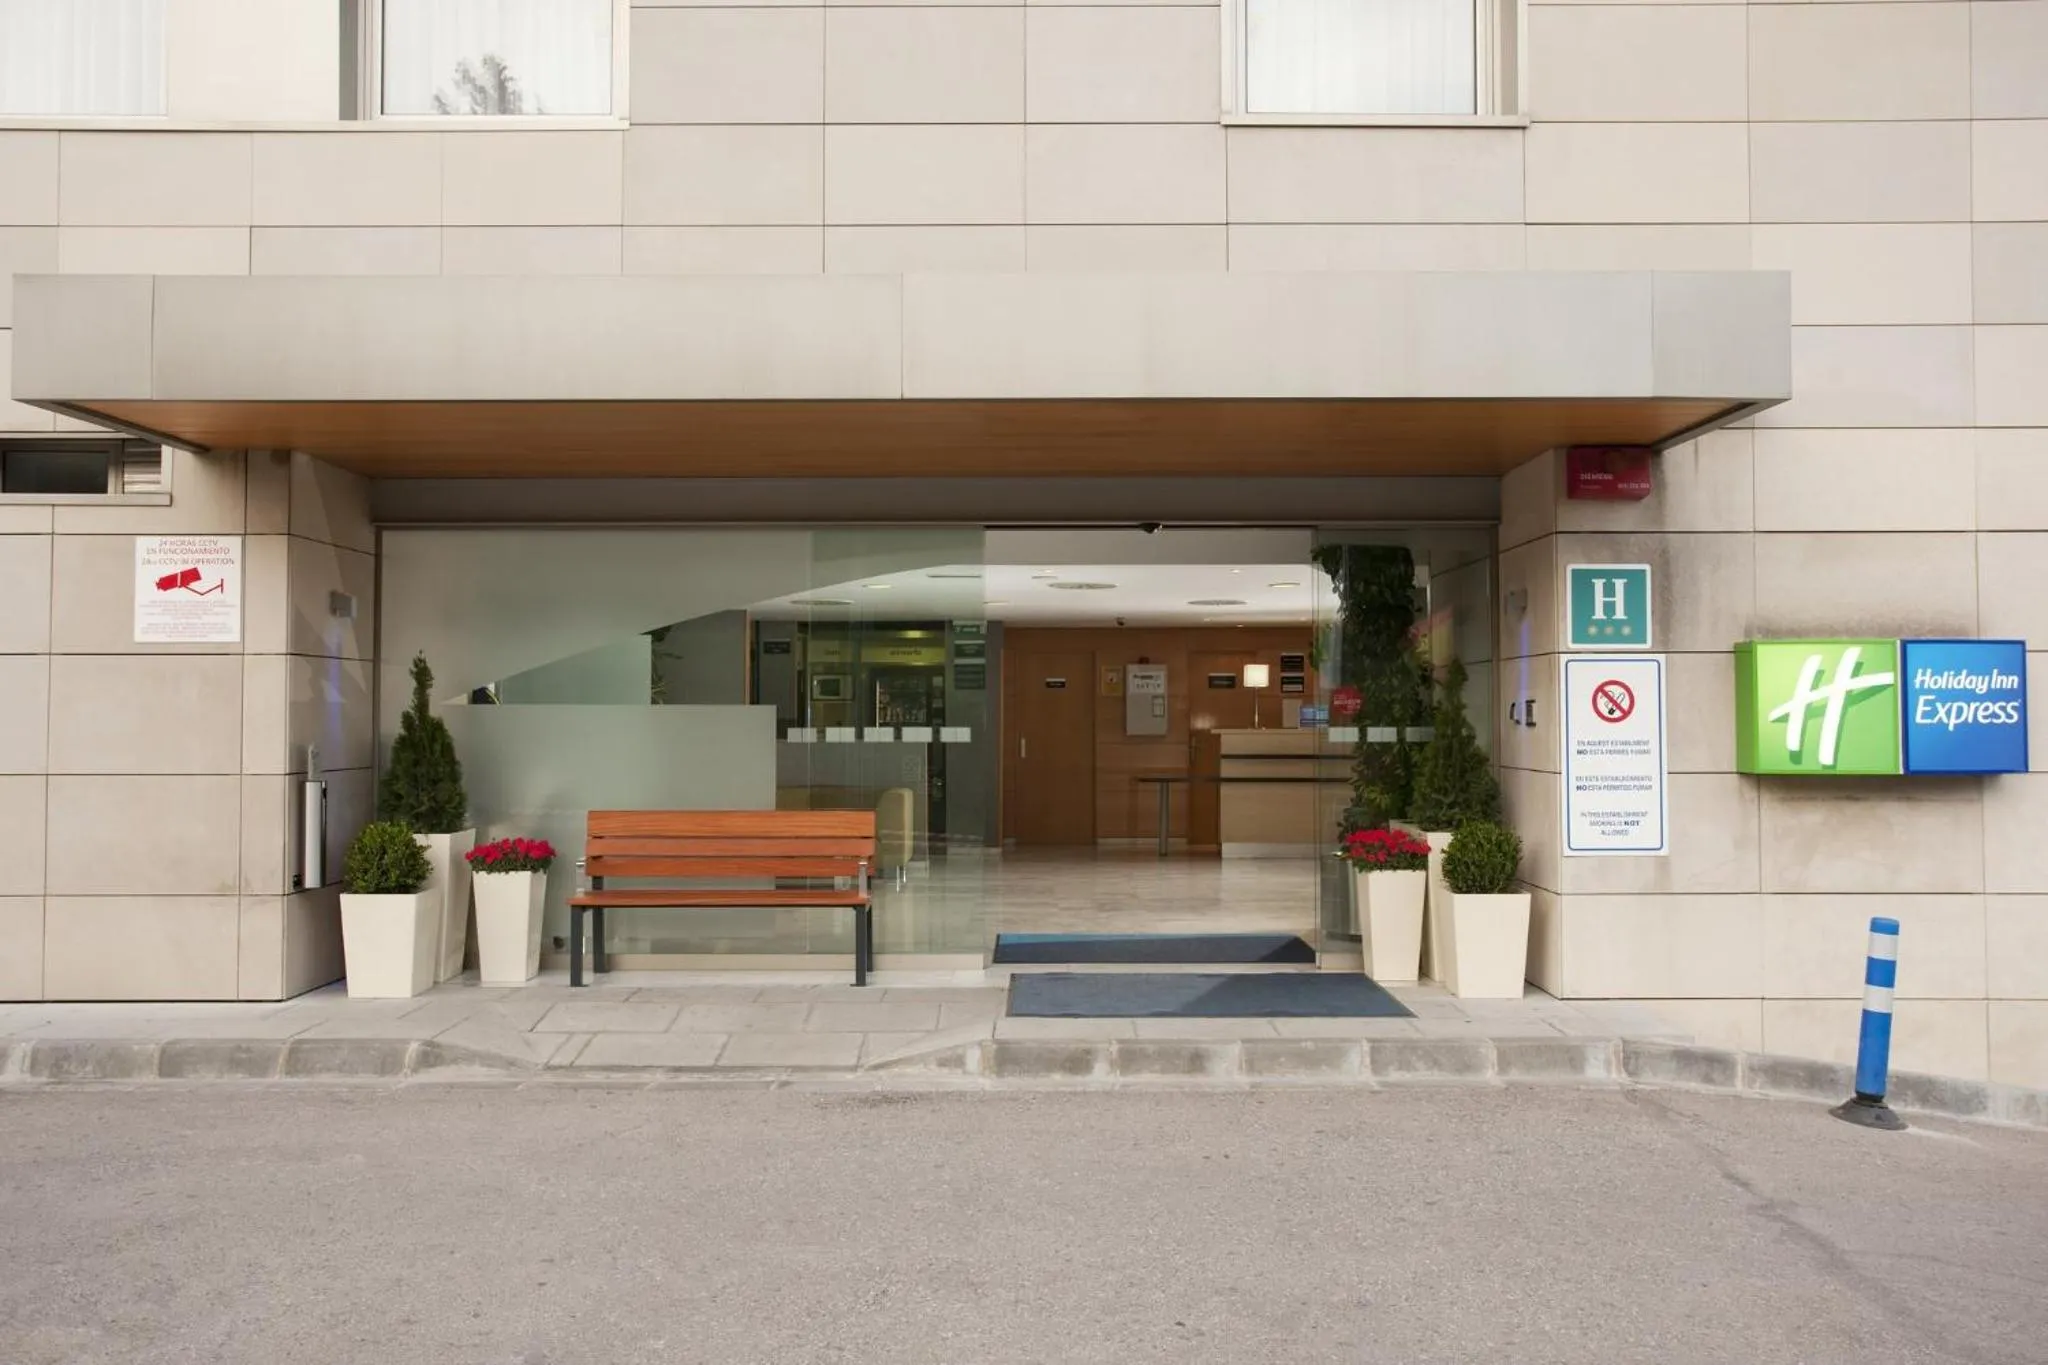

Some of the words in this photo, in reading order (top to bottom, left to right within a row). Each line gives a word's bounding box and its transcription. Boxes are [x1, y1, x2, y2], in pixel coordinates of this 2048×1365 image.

[159, 547, 230, 555] FUNCIONAMIENTO
[169, 539, 196, 547] HORAS
[198, 539, 219, 547] CCTV
[190, 557, 235, 566] OPERATION
[1592, 578, 1628, 620] H
[1914, 668, 1990, 694] Holiday
[1991, 668, 2019, 689] Inn
[1915, 695, 2020, 732] Express
